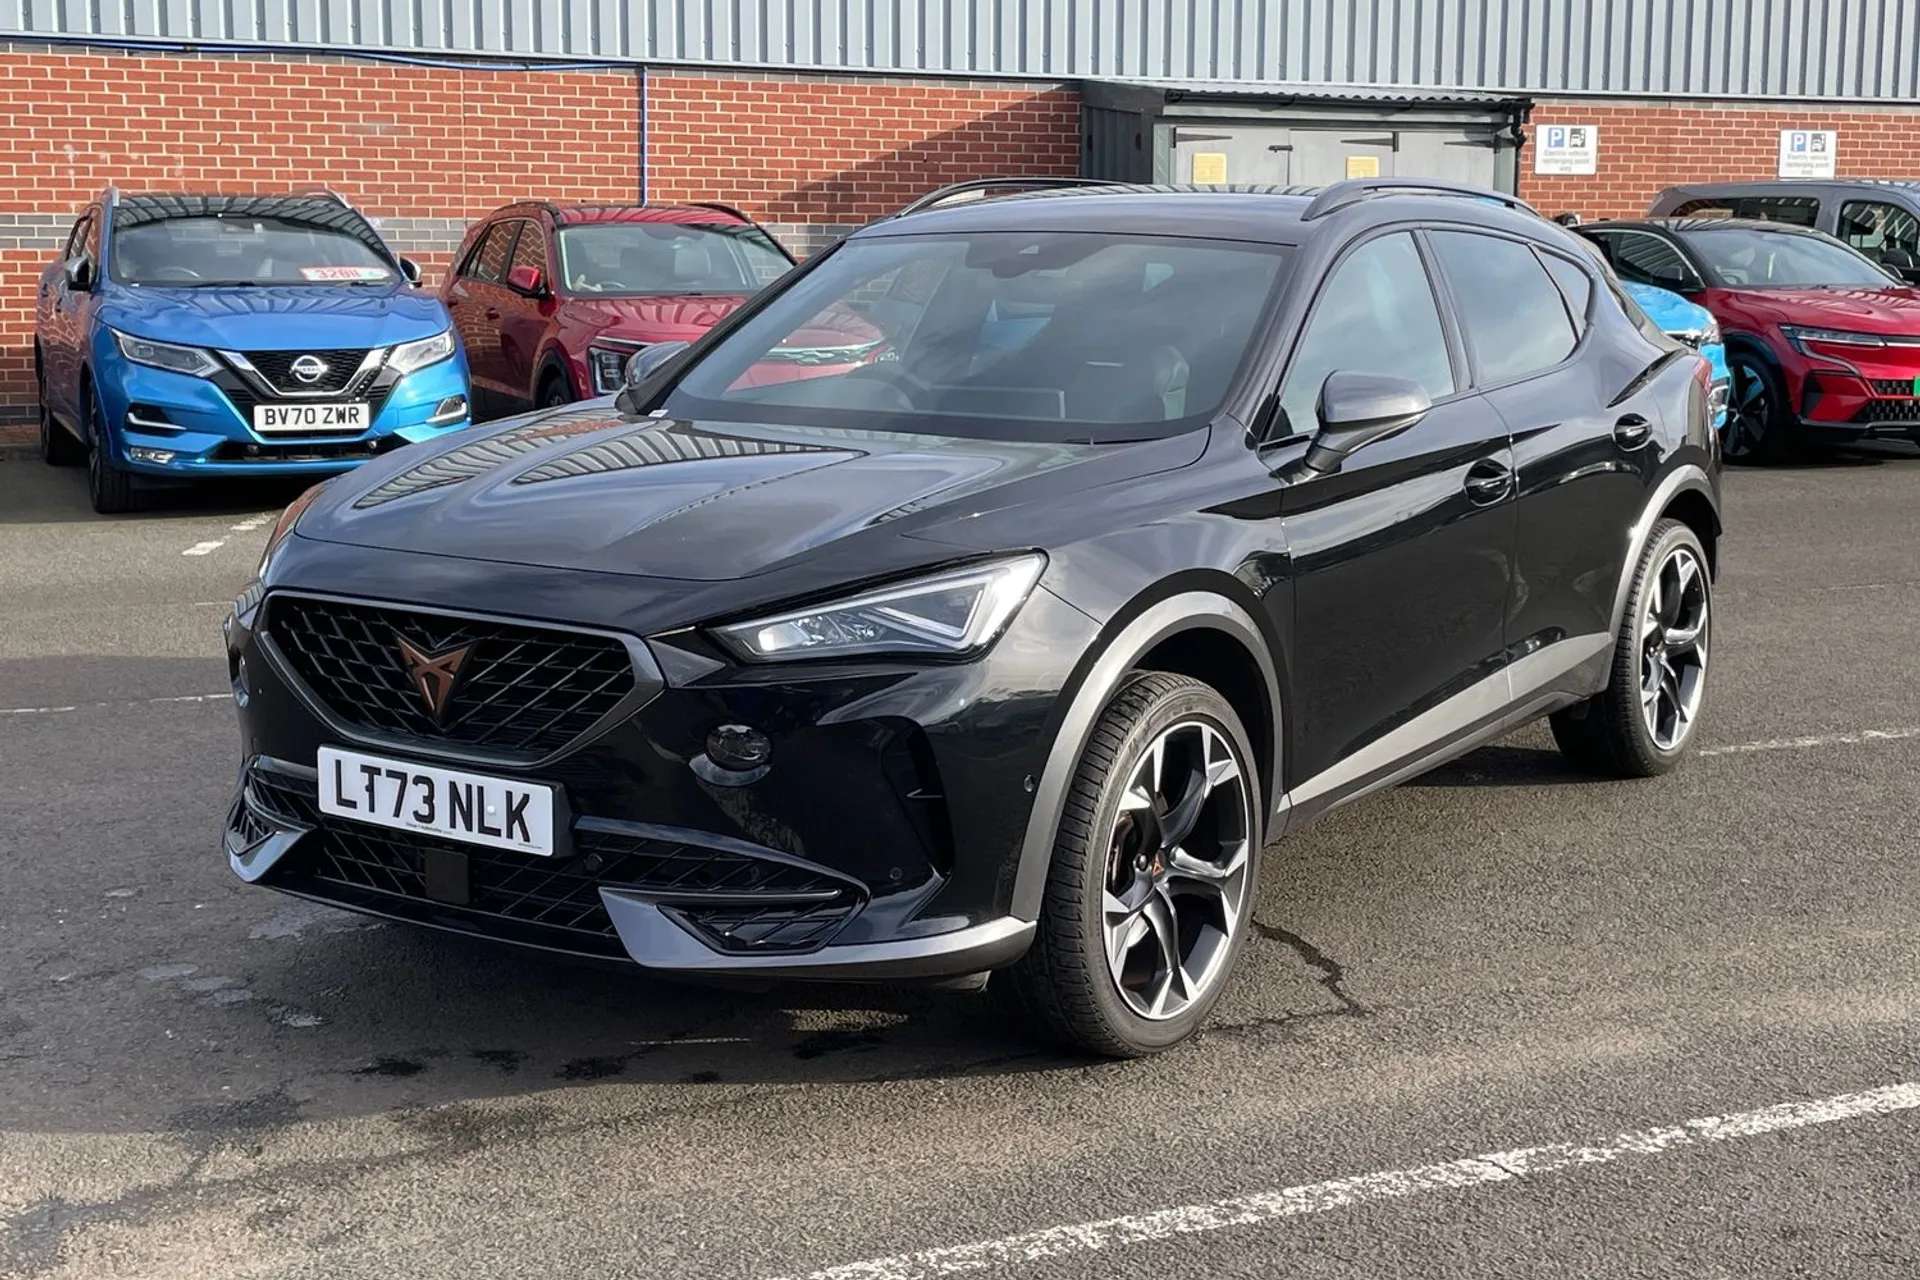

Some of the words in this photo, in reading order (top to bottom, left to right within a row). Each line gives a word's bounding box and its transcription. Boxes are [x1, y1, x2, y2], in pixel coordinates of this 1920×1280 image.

[1551, 129, 1562, 146] P
[1794, 134, 1804, 151] P
[264, 408, 315, 425] BV70
[322, 407, 359, 424] ZWR
[335, 759, 435, 824] LT73
[449, 780, 531, 843] NLK
